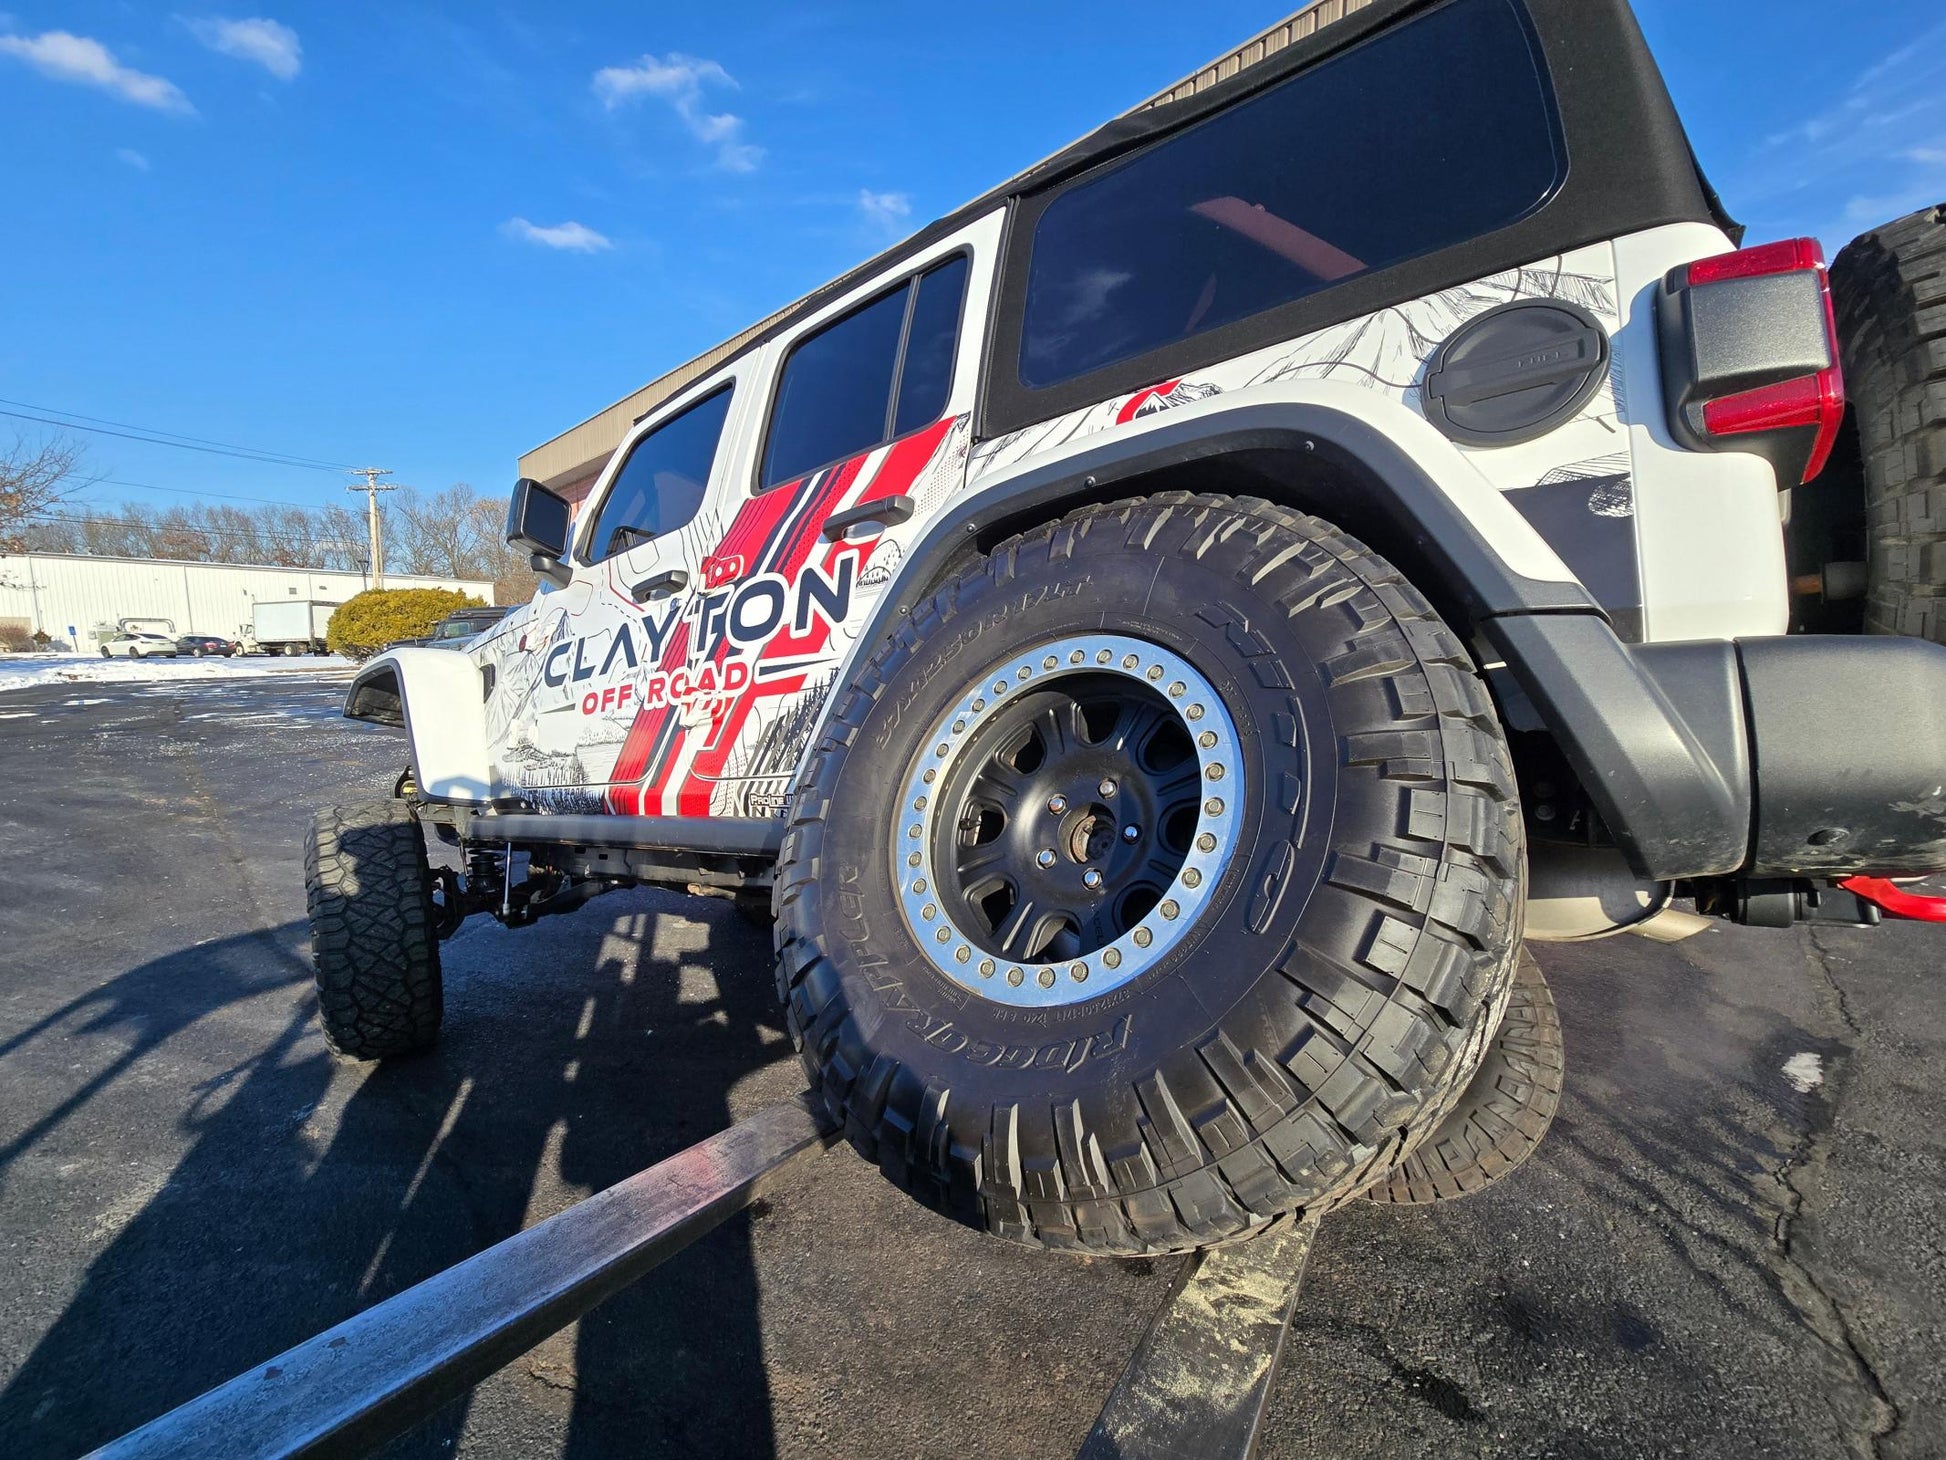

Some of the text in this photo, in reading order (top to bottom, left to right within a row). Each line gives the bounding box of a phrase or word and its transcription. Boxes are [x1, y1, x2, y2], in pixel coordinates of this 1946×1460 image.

[545, 556, 854, 687] CLAYTON
[582, 661, 749, 716] OFF ROAD
